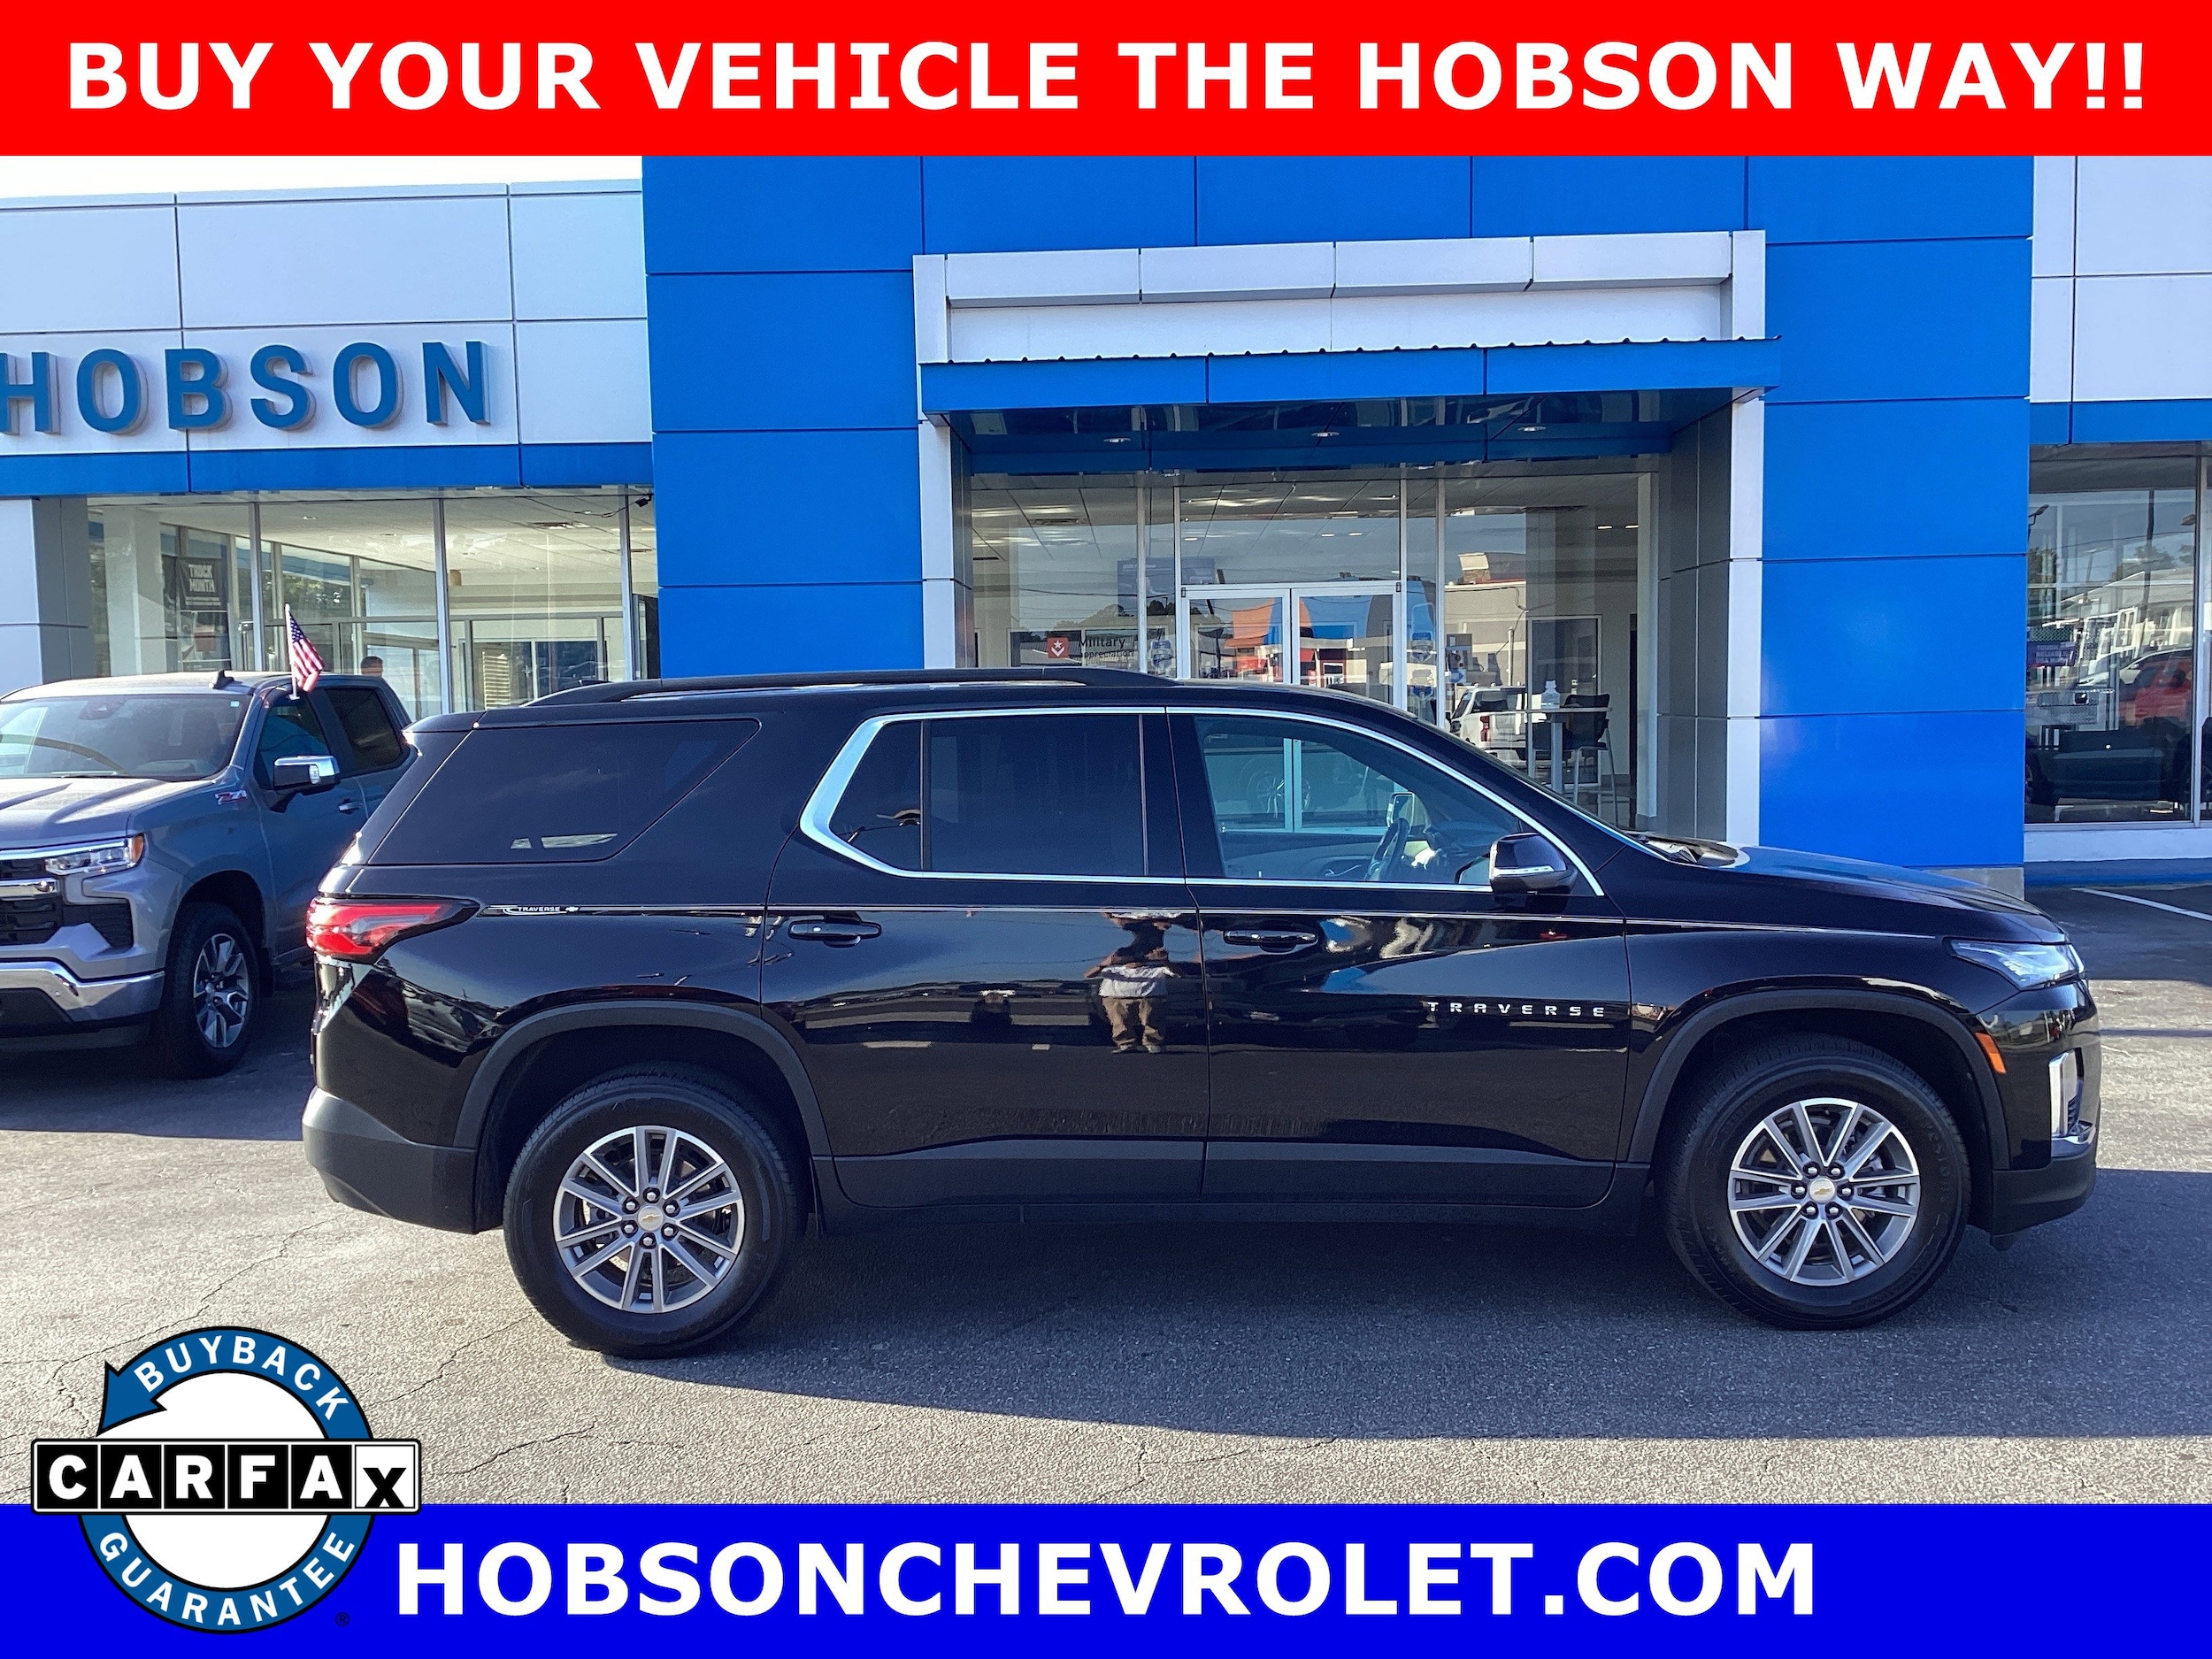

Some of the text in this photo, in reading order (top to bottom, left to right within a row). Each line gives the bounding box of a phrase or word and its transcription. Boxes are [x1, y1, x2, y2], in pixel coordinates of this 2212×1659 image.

[0, 341, 491, 434] HOBSON
[188, 564, 213, 578] TRUCK
[189, 578, 215, 592] MONTH
[1427, 1002, 1605, 1018] TRAVERSE
